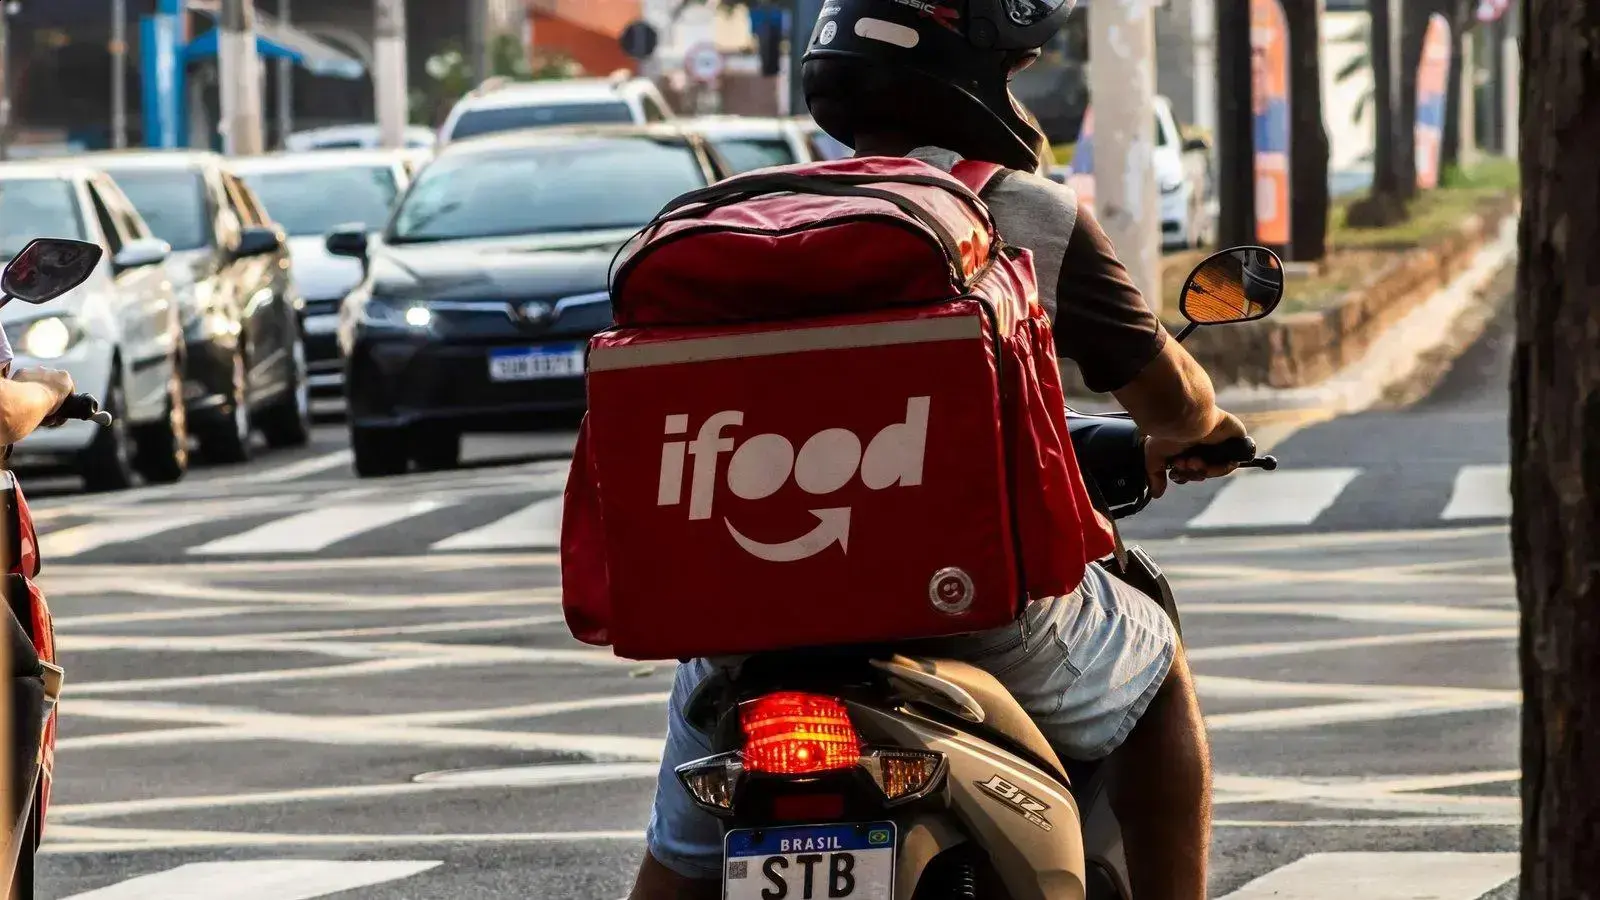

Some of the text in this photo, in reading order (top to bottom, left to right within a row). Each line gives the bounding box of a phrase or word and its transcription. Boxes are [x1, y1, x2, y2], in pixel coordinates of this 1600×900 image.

[657, 396, 931, 520] ifood
[1024, 811, 1054, 832] 125
[780, 836, 842, 852] BRASIL
[761, 852, 856, 900] STB
